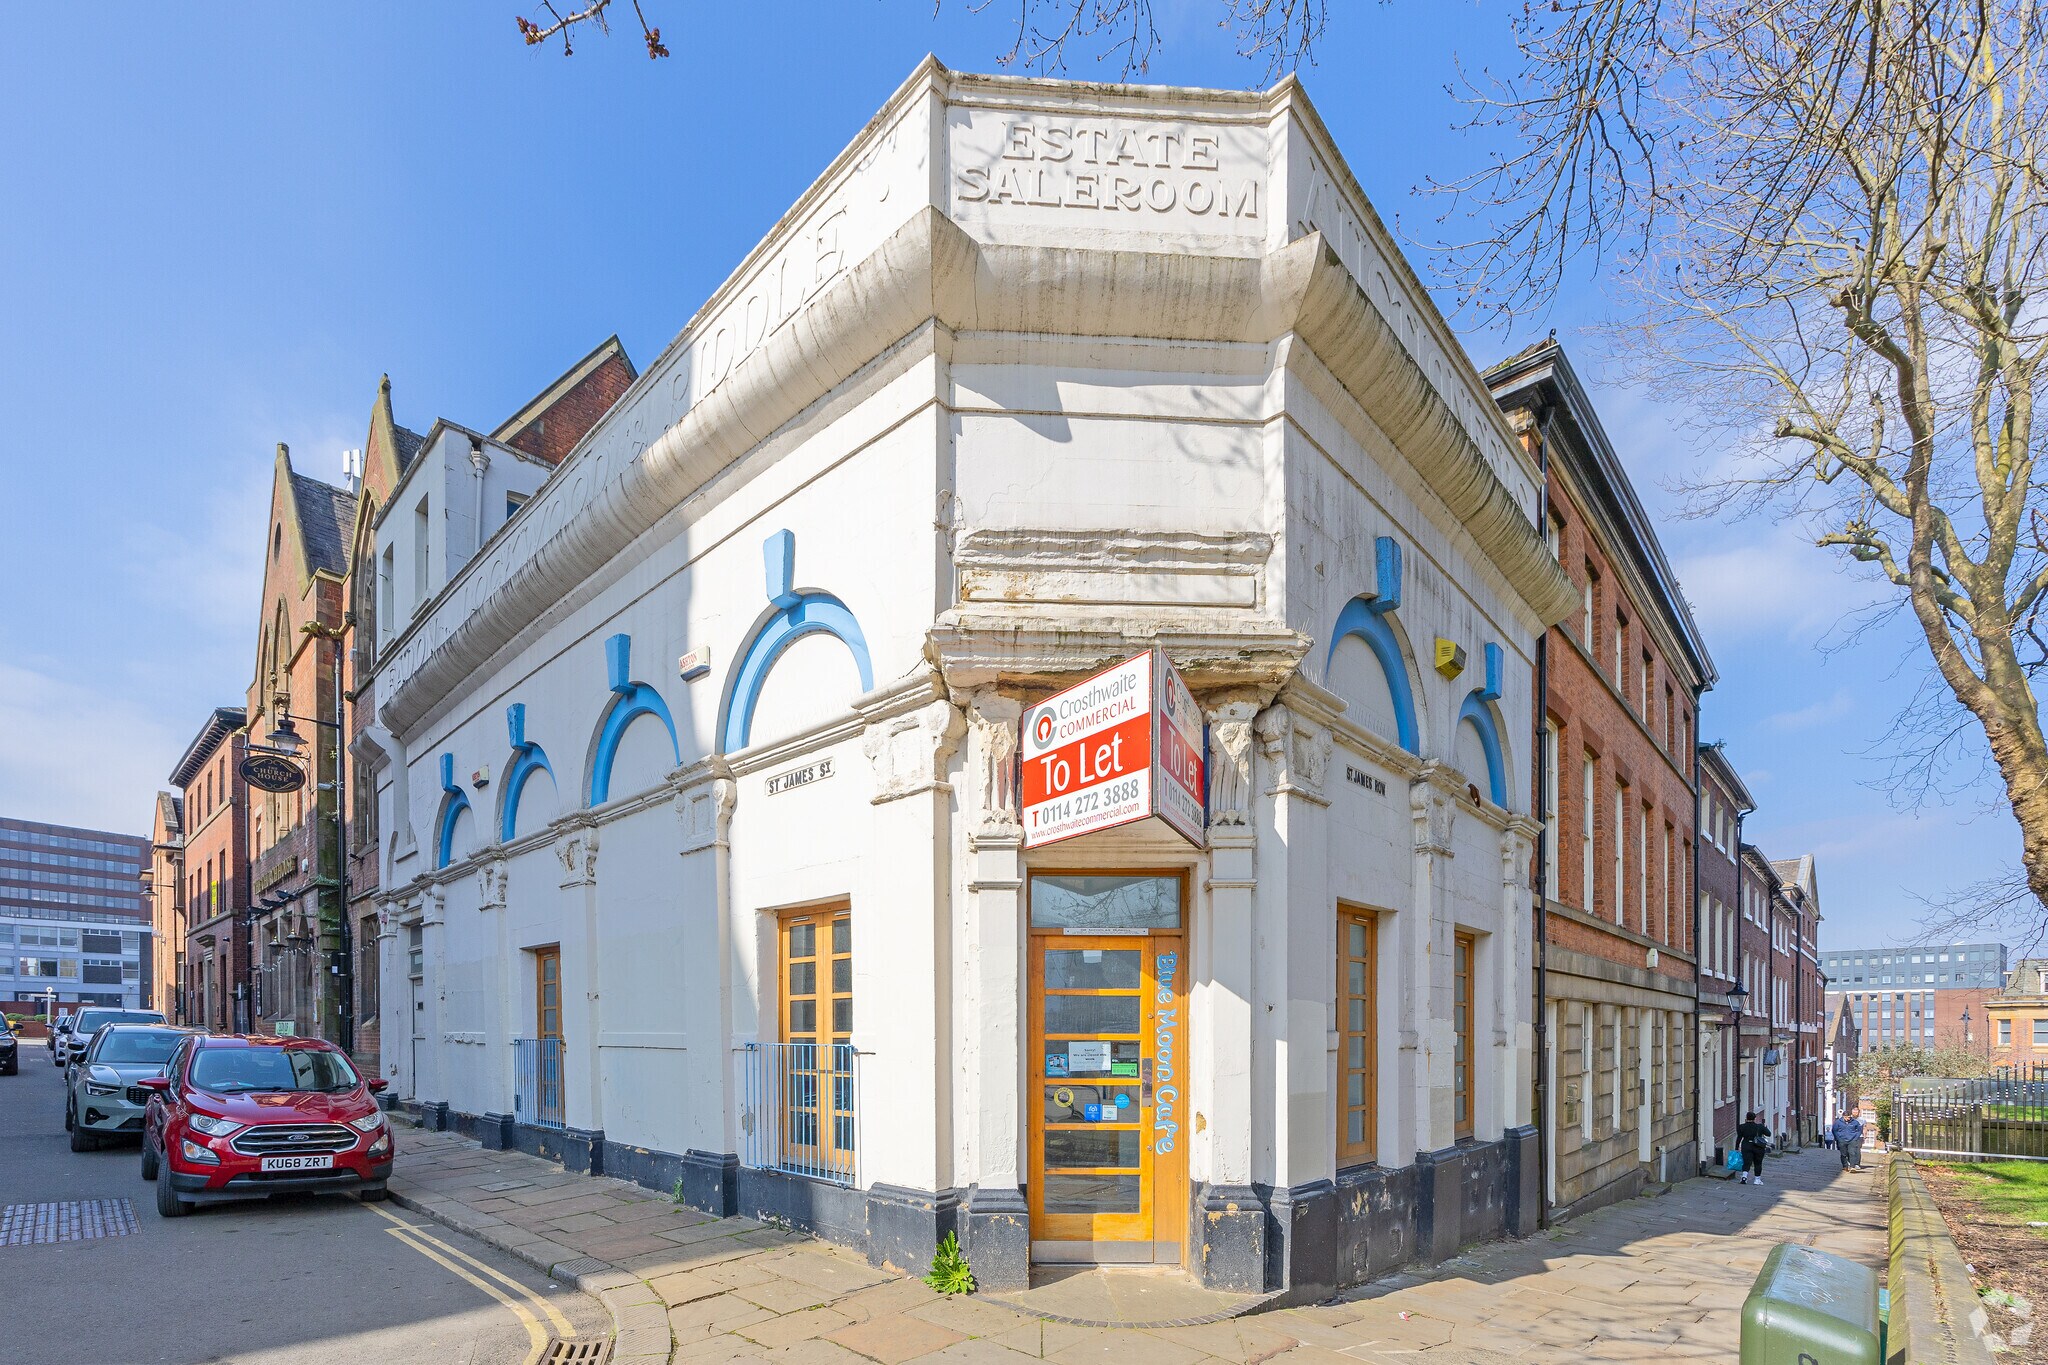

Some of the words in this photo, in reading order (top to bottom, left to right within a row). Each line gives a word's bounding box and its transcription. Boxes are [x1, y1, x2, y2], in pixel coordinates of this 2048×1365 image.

[1001, 120, 1219, 171] ESTATE
[957, 167, 1258, 219] SALEROOM
[1060, 673, 1137, 720] Crosthwaite
[1060, 696, 1137, 739] COMMERCIAL
[253, 767, 292, 778] CHURCH
[257, 772, 289, 782] HOUSE
[769, 777, 780, 793] ST
[784, 767, 814, 788] JAMES
[819, 761, 831, 777] ST
[1040, 753, 1071, 795] To
[1079, 732, 1124, 784] Let
[1168, 725, 1181, 777] To
[1183, 743, 1198, 796] Let
[1353, 770, 1373, 790] JAMES
[1032, 810, 1039, 828] T
[1042, 801, 1071, 825] 0114
[1075, 791, 1099, 816] 272
[1103, 778, 1139, 807] 3888
[1168, 781, 1181, 809] 0114
[1030, 802, 1140, 840] www.crosthwaitecommercial.com
[1156, 950, 1178, 1004] Blue
[1156, 1008, 1178, 1082] Moon
[267, 1158, 301, 1169] KU68
[304, 1156, 329, 1168] ZRT
